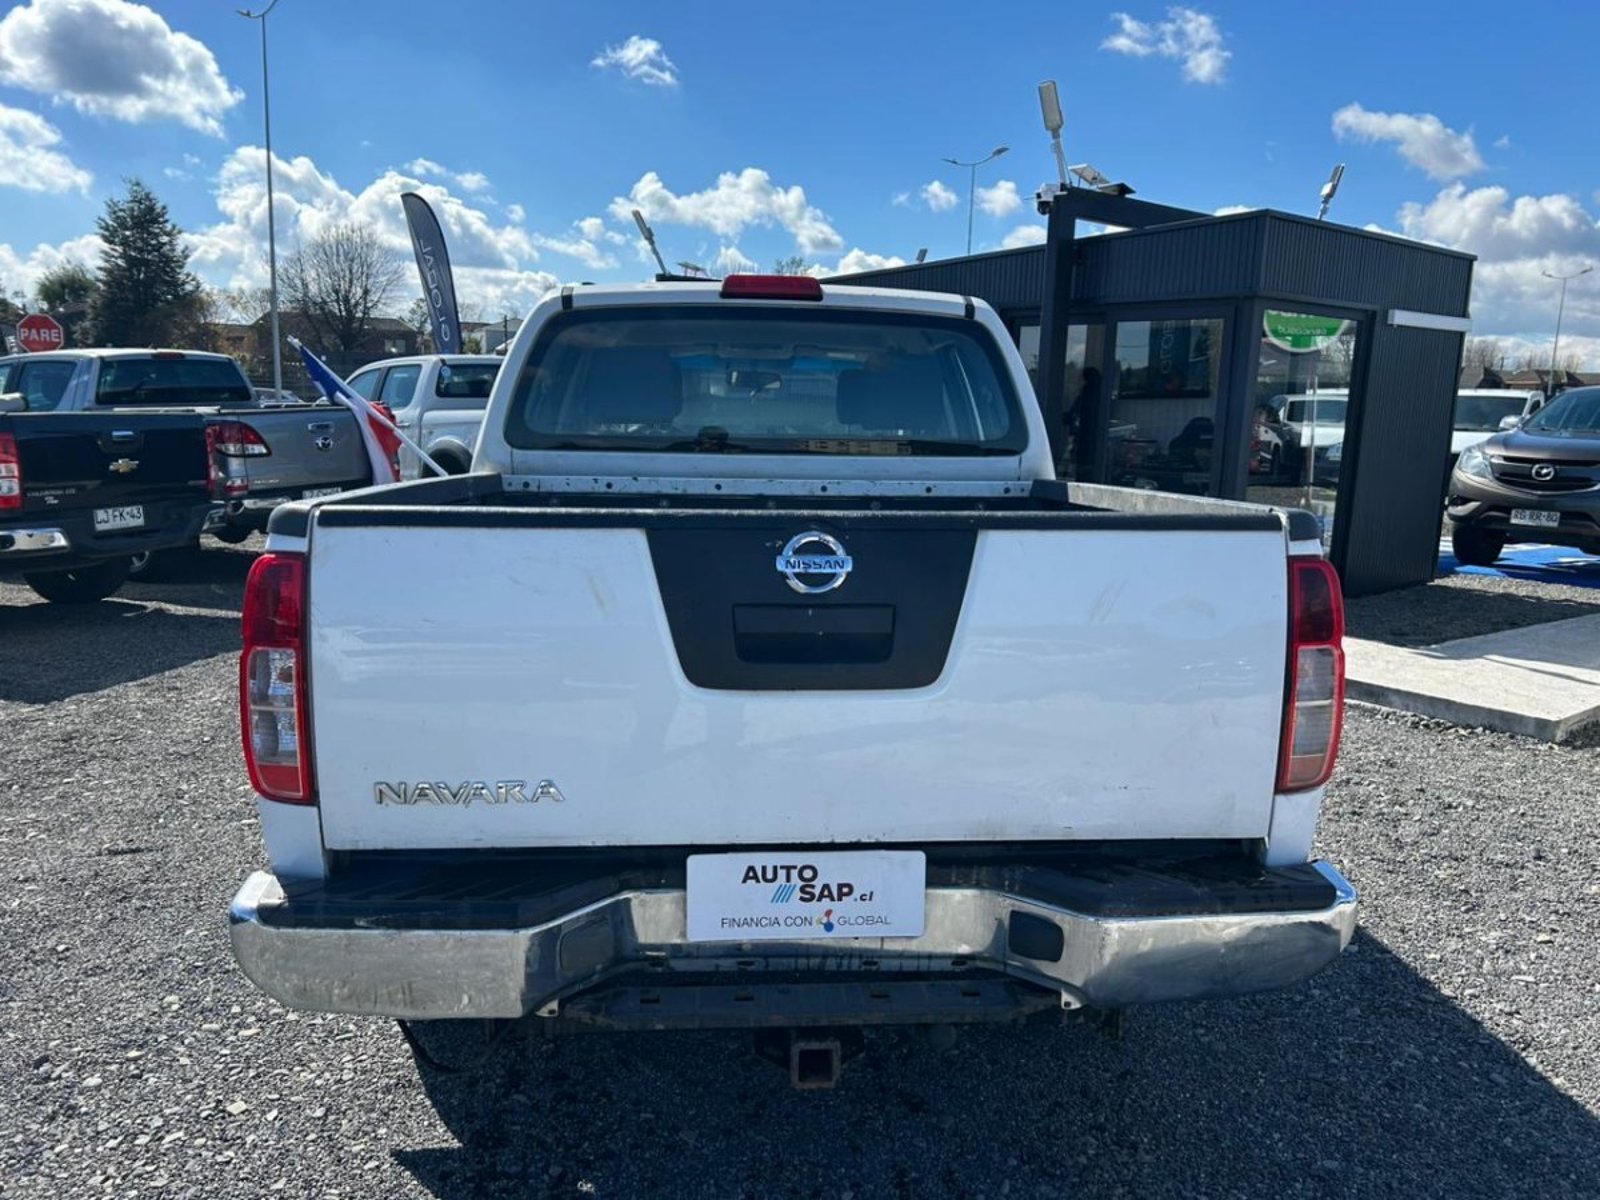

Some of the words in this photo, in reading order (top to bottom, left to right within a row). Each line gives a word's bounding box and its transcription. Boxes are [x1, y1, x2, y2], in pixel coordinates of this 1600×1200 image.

[20, 328, 60, 342] PARE
[785, 559, 845, 570] NISSAN
[374, 779, 565, 807] NAVARA
[741, 864, 819, 884] AUTO
[720, 916, 782, 928] FINANCIA
[784, 915, 813, 928] CON
[837, 915, 892, 926] GLOBAL
